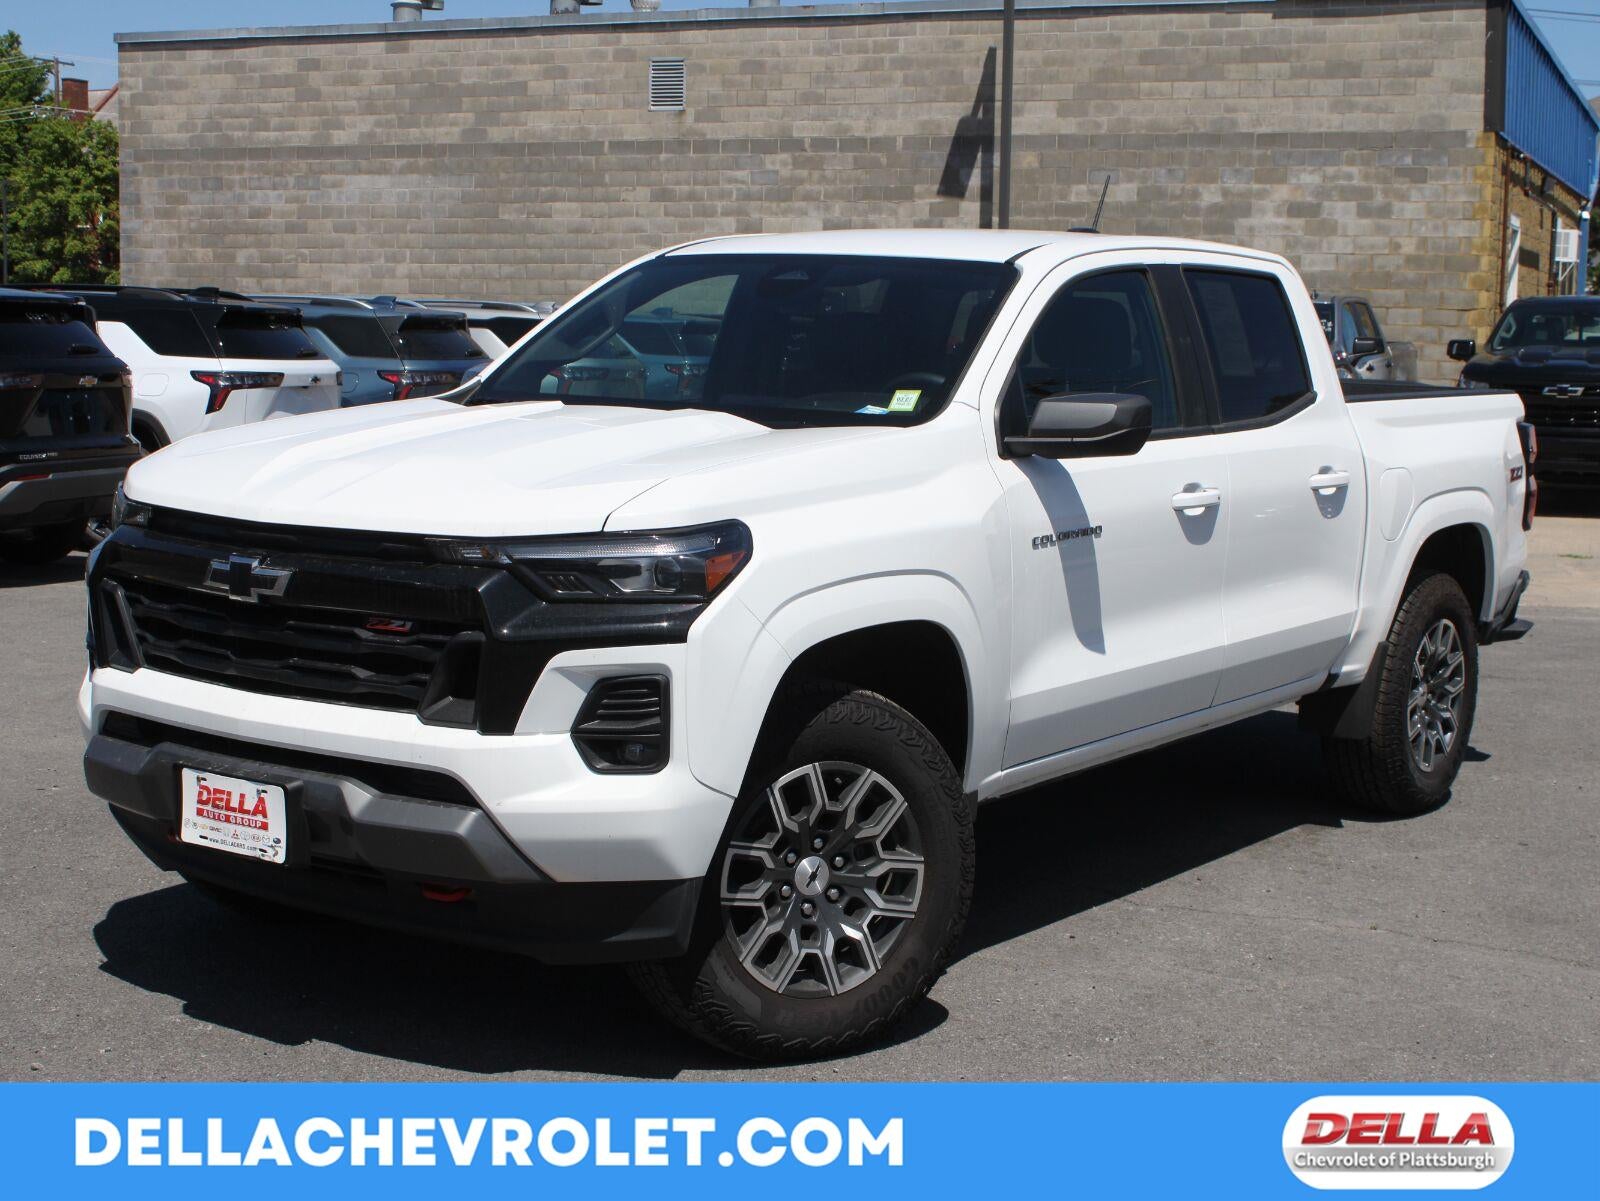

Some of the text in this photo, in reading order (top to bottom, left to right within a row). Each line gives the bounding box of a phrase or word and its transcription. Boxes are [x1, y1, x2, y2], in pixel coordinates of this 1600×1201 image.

[1032, 525, 1102, 548] COLORADO
[196, 785, 268, 818] DELLA
[203, 809, 262, 828] AUTO GROUP
